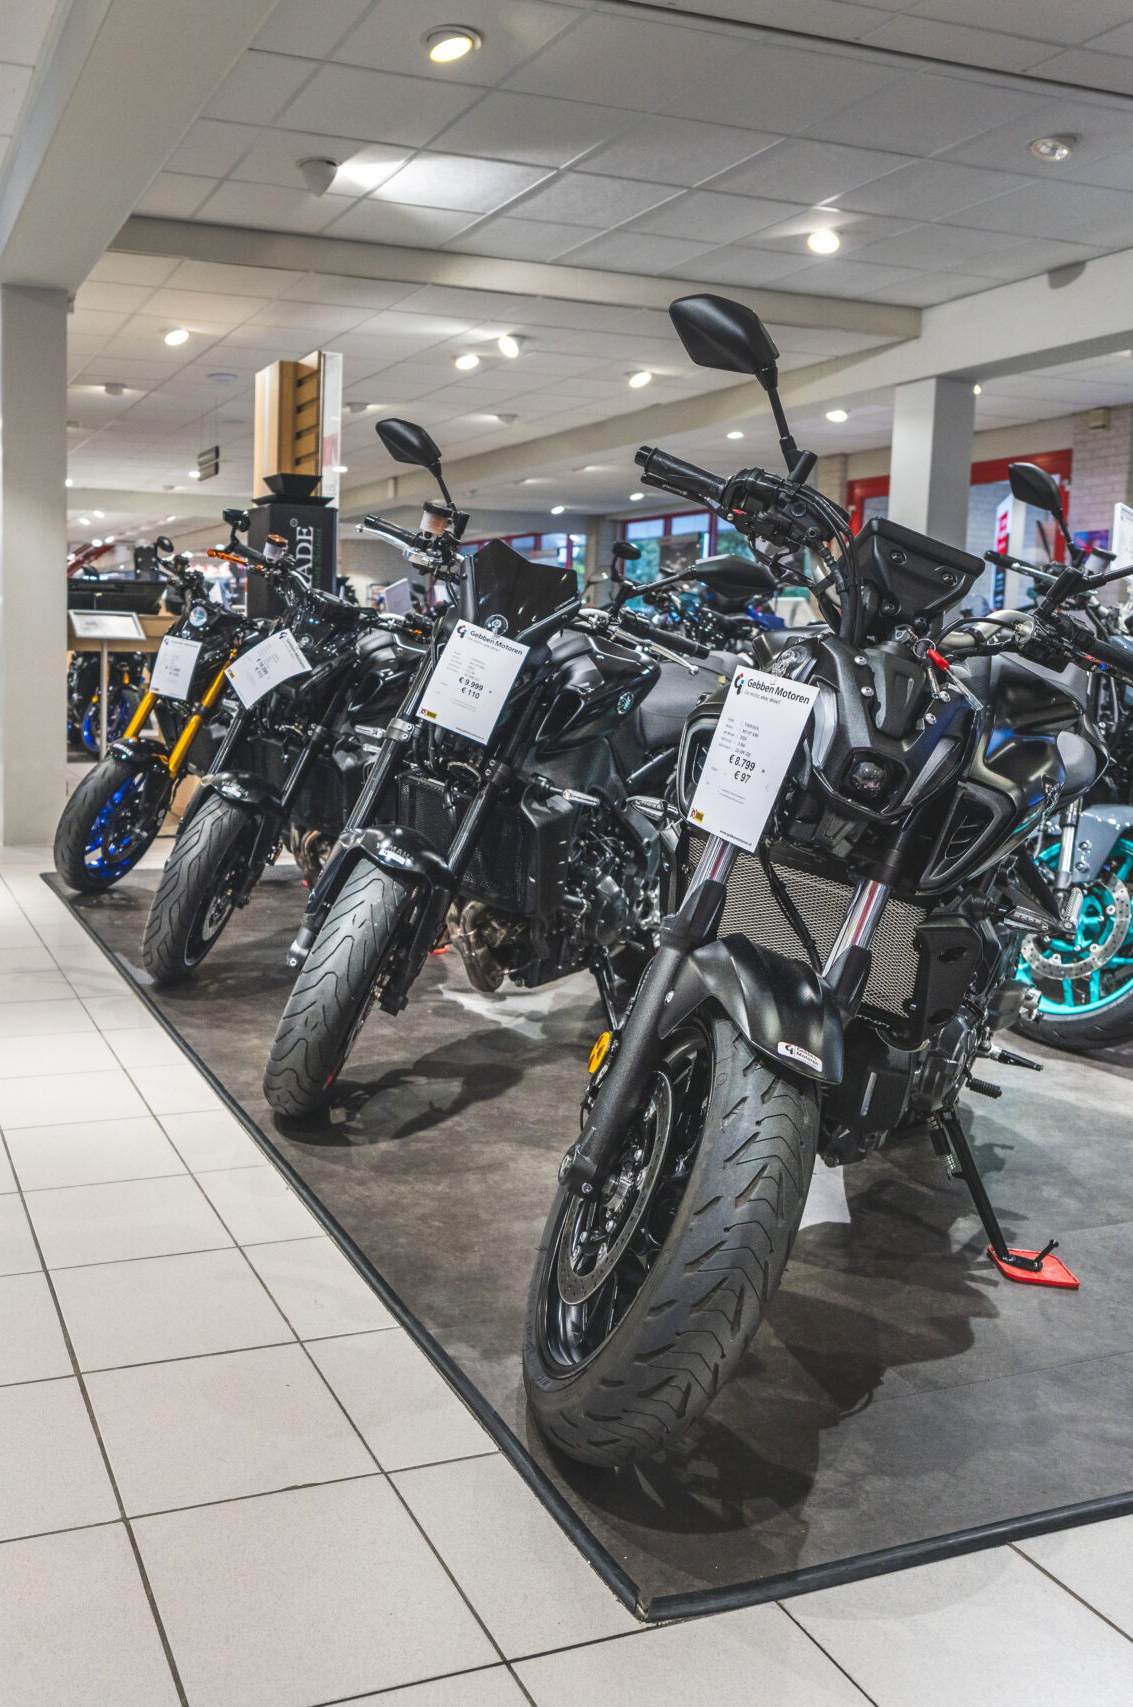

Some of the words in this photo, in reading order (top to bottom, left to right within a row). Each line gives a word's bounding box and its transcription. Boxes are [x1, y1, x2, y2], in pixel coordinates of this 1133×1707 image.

[296, 526, 314, 588] ADE
[470, 630, 495, 645] Gebben
[495, 640, 523, 656] Motoren
[468, 689, 480, 700] 110
[747, 678, 774, 695] Gebben
[774, 687, 810, 704] Motoren
[735, 756, 756, 772] 8.799
[741, 773, 751, 784] 97
